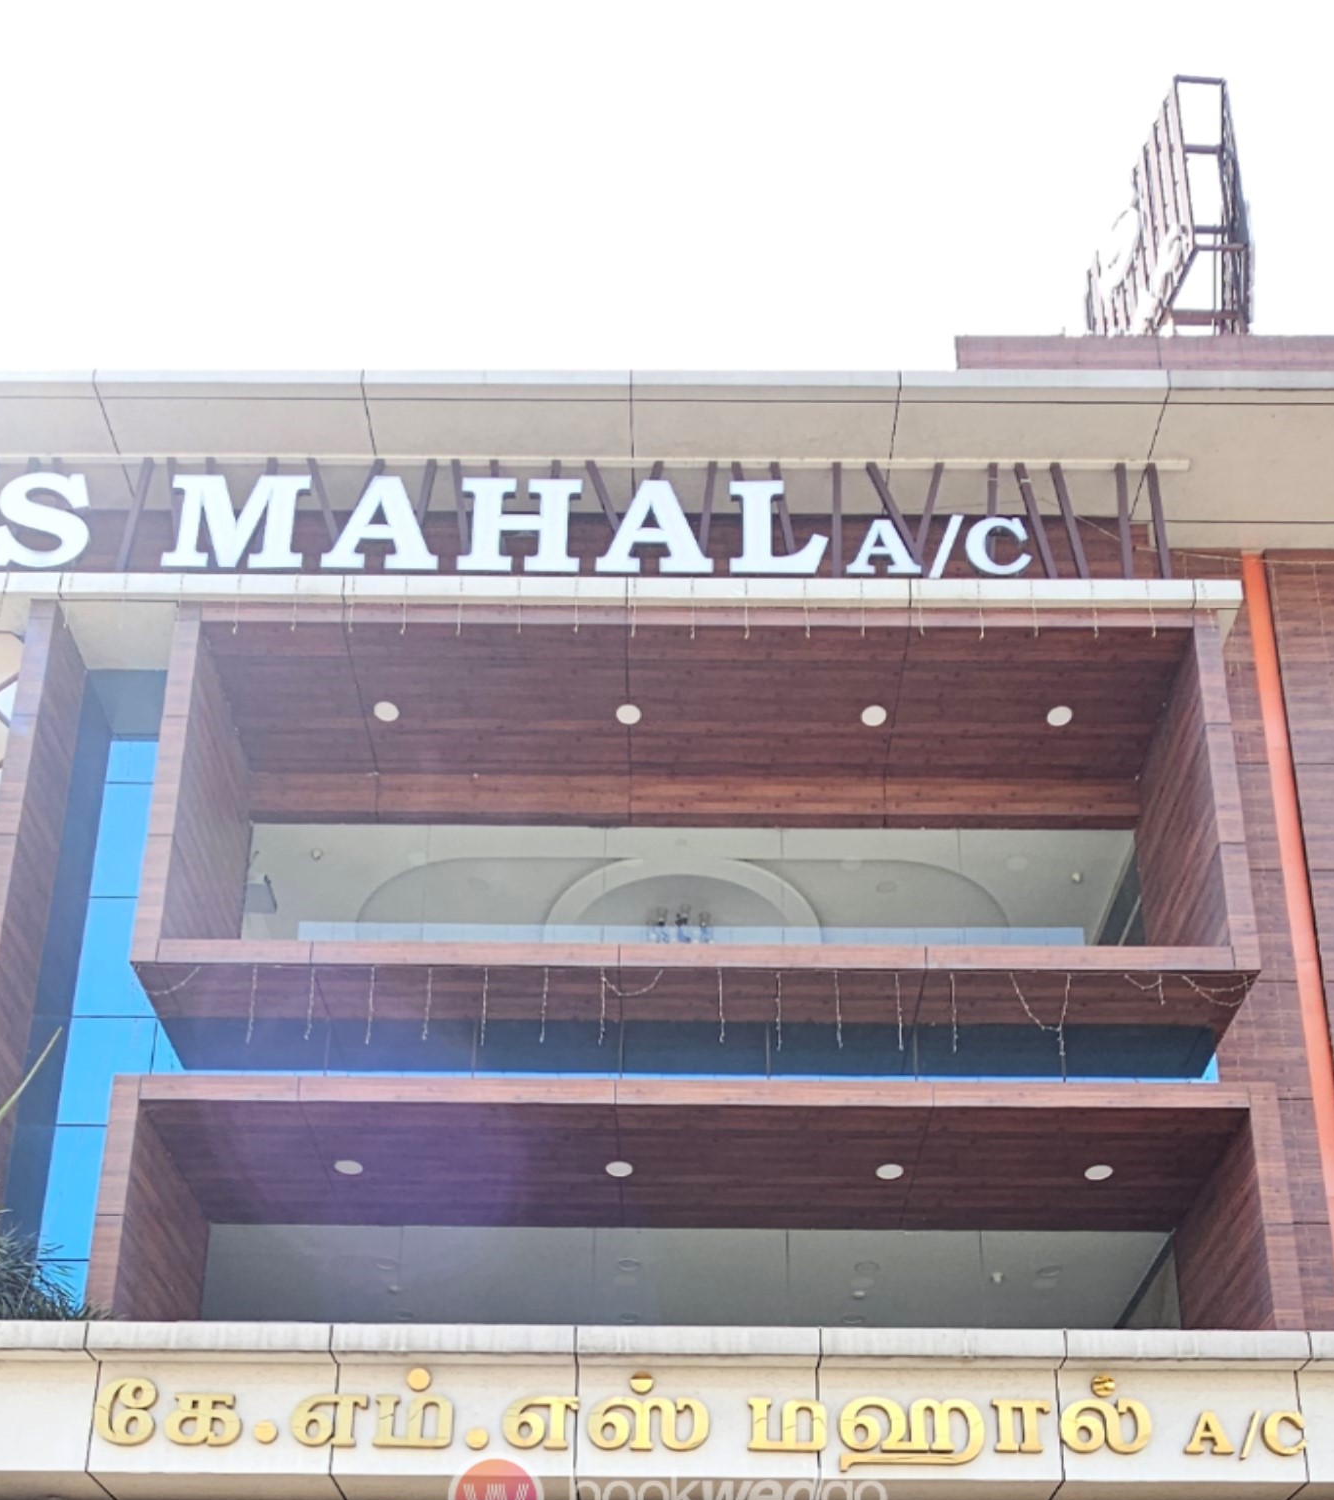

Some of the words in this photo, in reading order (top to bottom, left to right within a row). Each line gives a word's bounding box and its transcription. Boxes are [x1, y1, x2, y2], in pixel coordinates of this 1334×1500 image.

[160, 473, 829, 575] MAHAL
[845, 513, 1034, 579] A/C
[747, 1374, 1153, 1472] மஹால்
[1184, 1409, 1307, 1460] A/C
